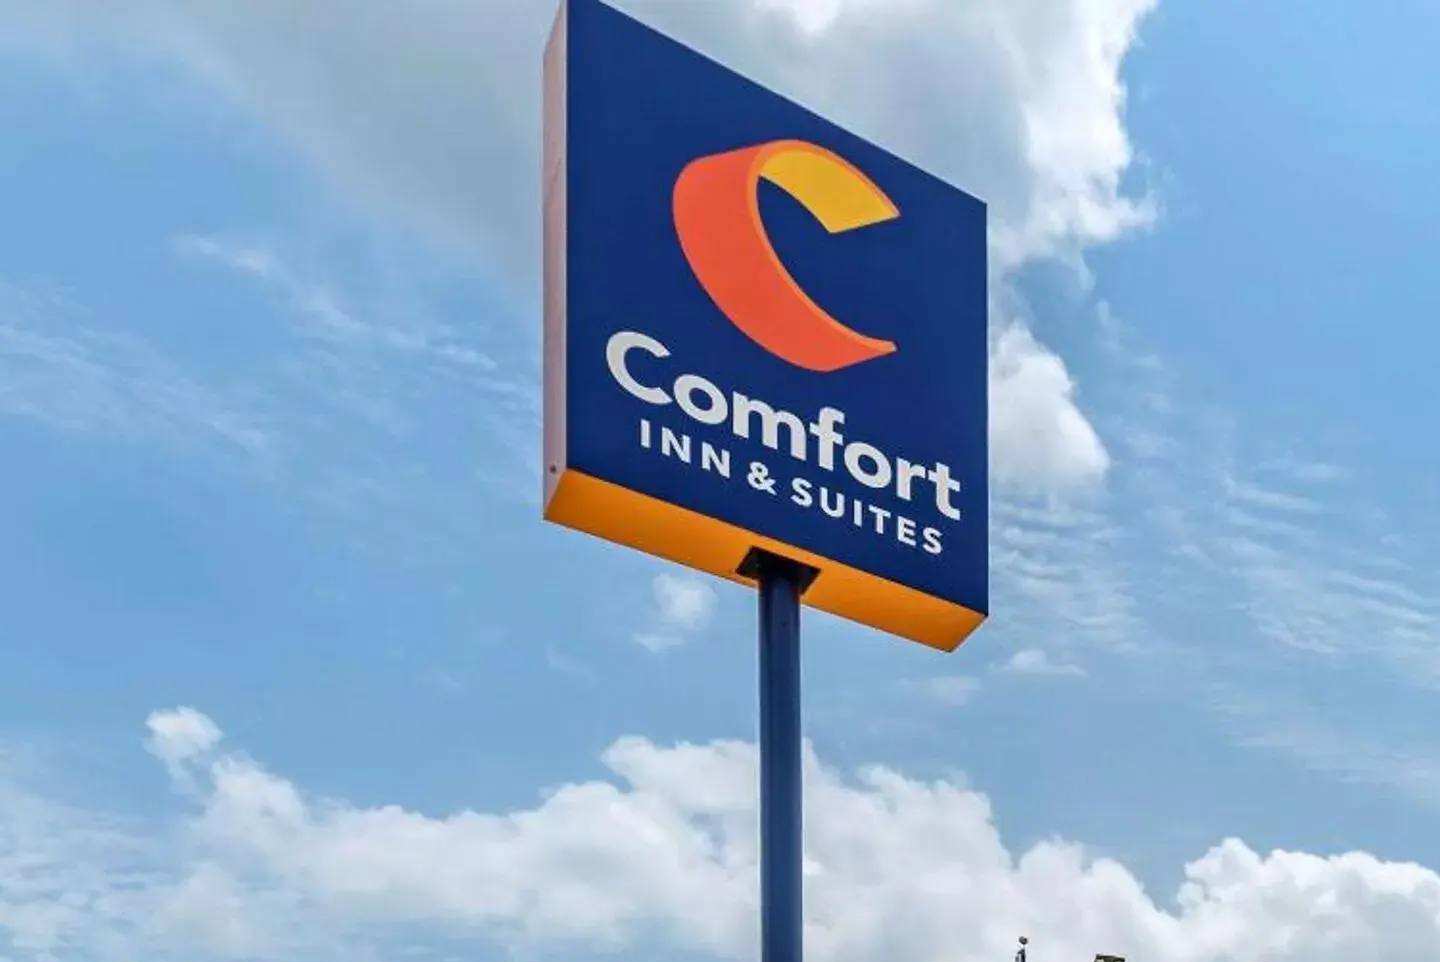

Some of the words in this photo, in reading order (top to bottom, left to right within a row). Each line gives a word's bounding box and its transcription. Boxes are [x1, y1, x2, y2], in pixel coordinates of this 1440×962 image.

[606, 331, 961, 521] Comfort
[640, 418, 731, 479] INN
[747, 461, 777, 495] &
[790, 477, 943, 554] SUITES
